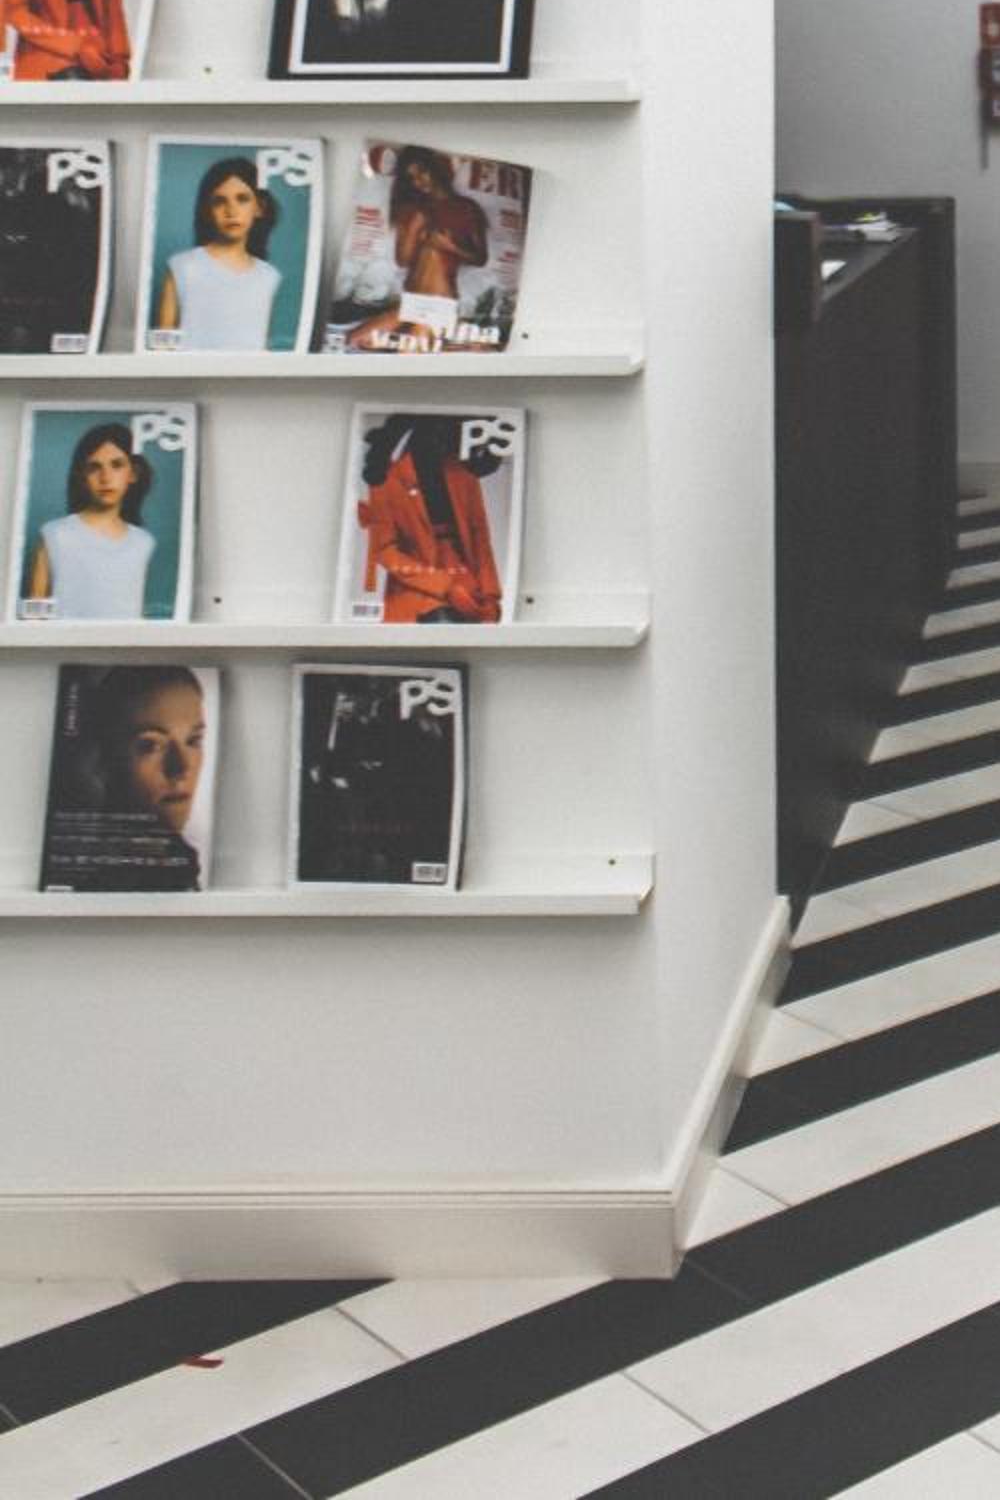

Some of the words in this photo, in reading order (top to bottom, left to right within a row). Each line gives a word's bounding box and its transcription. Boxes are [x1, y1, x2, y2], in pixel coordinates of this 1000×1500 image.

[47, 148, 104, 193] PS
[256, 147, 314, 190] PS
[131, 410, 187, 454] PS
[459, 416, 516, 461] PS
[400, 675, 455, 720] PS
